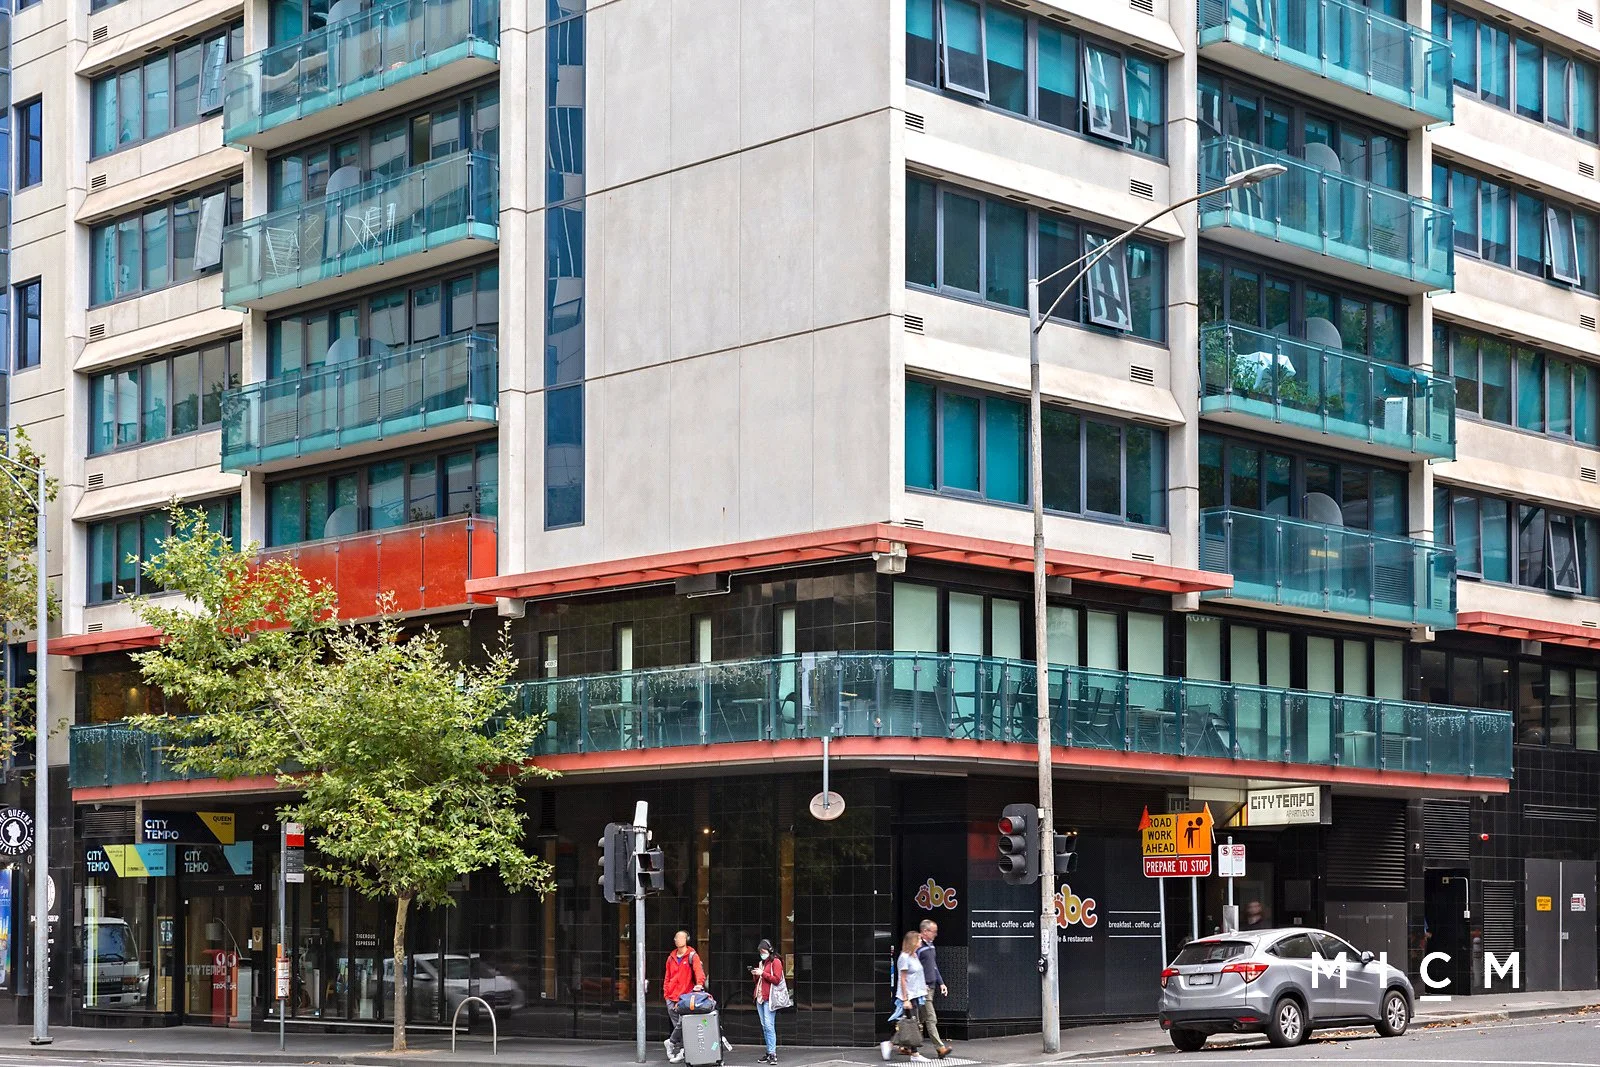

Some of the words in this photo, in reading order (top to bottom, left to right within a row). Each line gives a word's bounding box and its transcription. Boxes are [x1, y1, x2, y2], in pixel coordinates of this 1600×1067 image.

[7, 809, 33, 826] QUEENS
[1286, 809, 1315, 818] APARTMENTS
[1149, 818, 1171, 828] ROAD
[145, 830, 179, 840] TEMPO
[1147, 831, 1172, 841] WORK
[18, 836, 34, 854] SHOP
[1145, 843, 1175, 853] AHEAD
[86, 862, 110, 872] TEMPO
[184, 863, 209, 873] TEMPO
[1146, 860, 1177, 873] PREPARE
[1180, 859, 1188, 872] TO
[1191, 859, 1209, 872] STOP
[253, 883, 262, 891] 361
[915, 878, 958, 910] abc
[971, 920, 998, 928] breakfast
[1001, 920, 1019, 928] coffee
[1023, 920, 1035, 928] cafe
[1108, 921, 1132, 929] breakfast
[1134, 921, 1151, 929] coffee
[1067, 935, 1094, 943] restaurant
